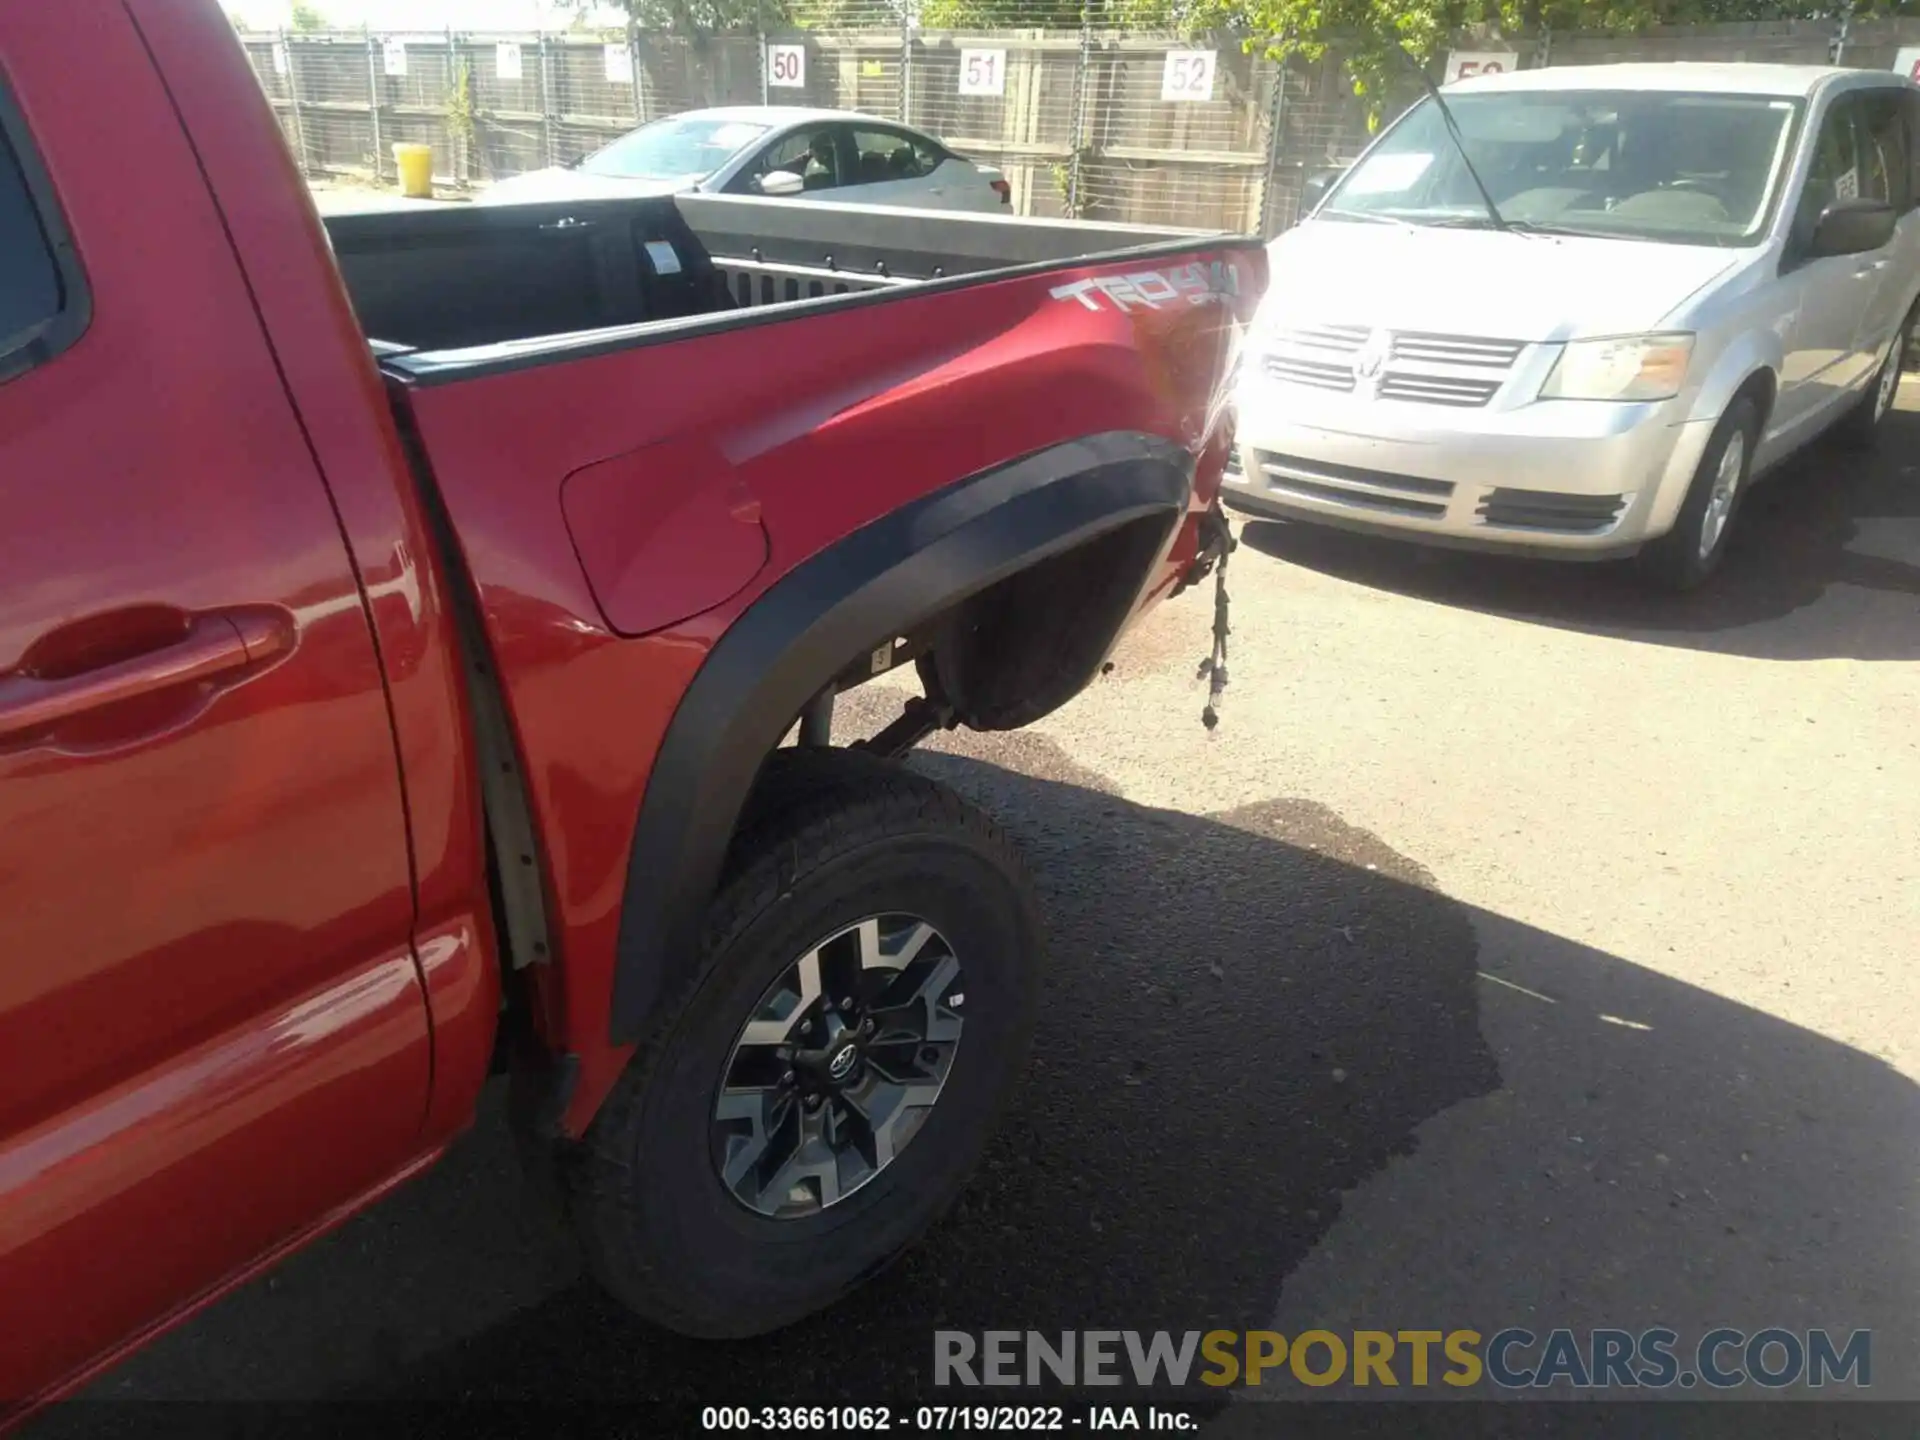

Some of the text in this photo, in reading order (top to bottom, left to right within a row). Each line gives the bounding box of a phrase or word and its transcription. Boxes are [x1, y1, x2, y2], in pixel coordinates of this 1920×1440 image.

[774, 52, 798, 80] 50
[967, 56, 995, 86] 51
[1171, 57, 1206, 91] 52
[1049, 271, 1177, 312] TRD
